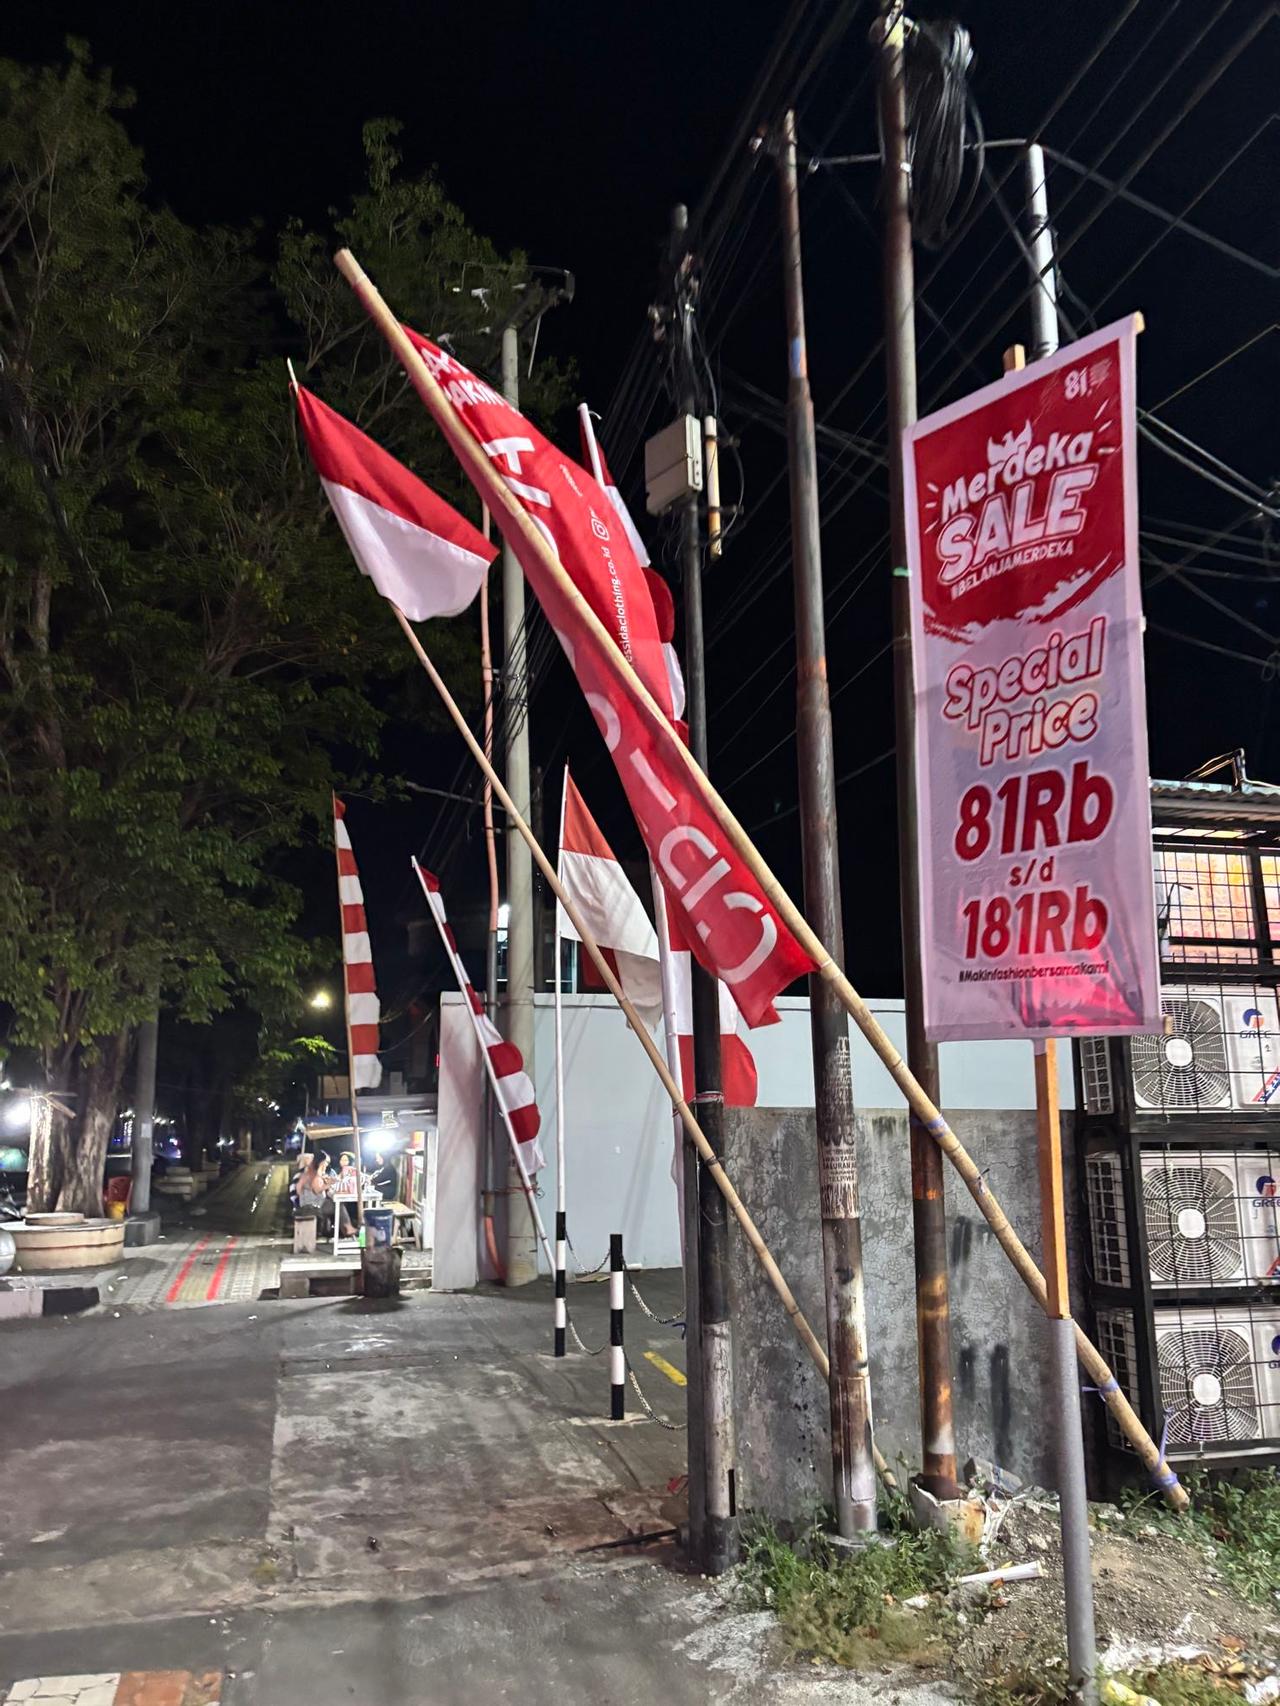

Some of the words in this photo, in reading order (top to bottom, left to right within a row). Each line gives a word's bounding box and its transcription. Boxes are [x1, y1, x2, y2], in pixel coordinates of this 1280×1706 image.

[942, 428, 1094, 523] Merdeka
[937, 463, 1099, 585] SALE
[601, 547, 633, 666] essidaclothing.co.id
[943, 616, 1106, 730] Special
[979, 693, 1098, 766] Price
[953, 760, 1113, 862] 81Rb
[1009, 855, 1055, 887] s/d
[962, 885, 1108, 960] 181Rb
[1240, 1029, 1272, 1039] GREE
